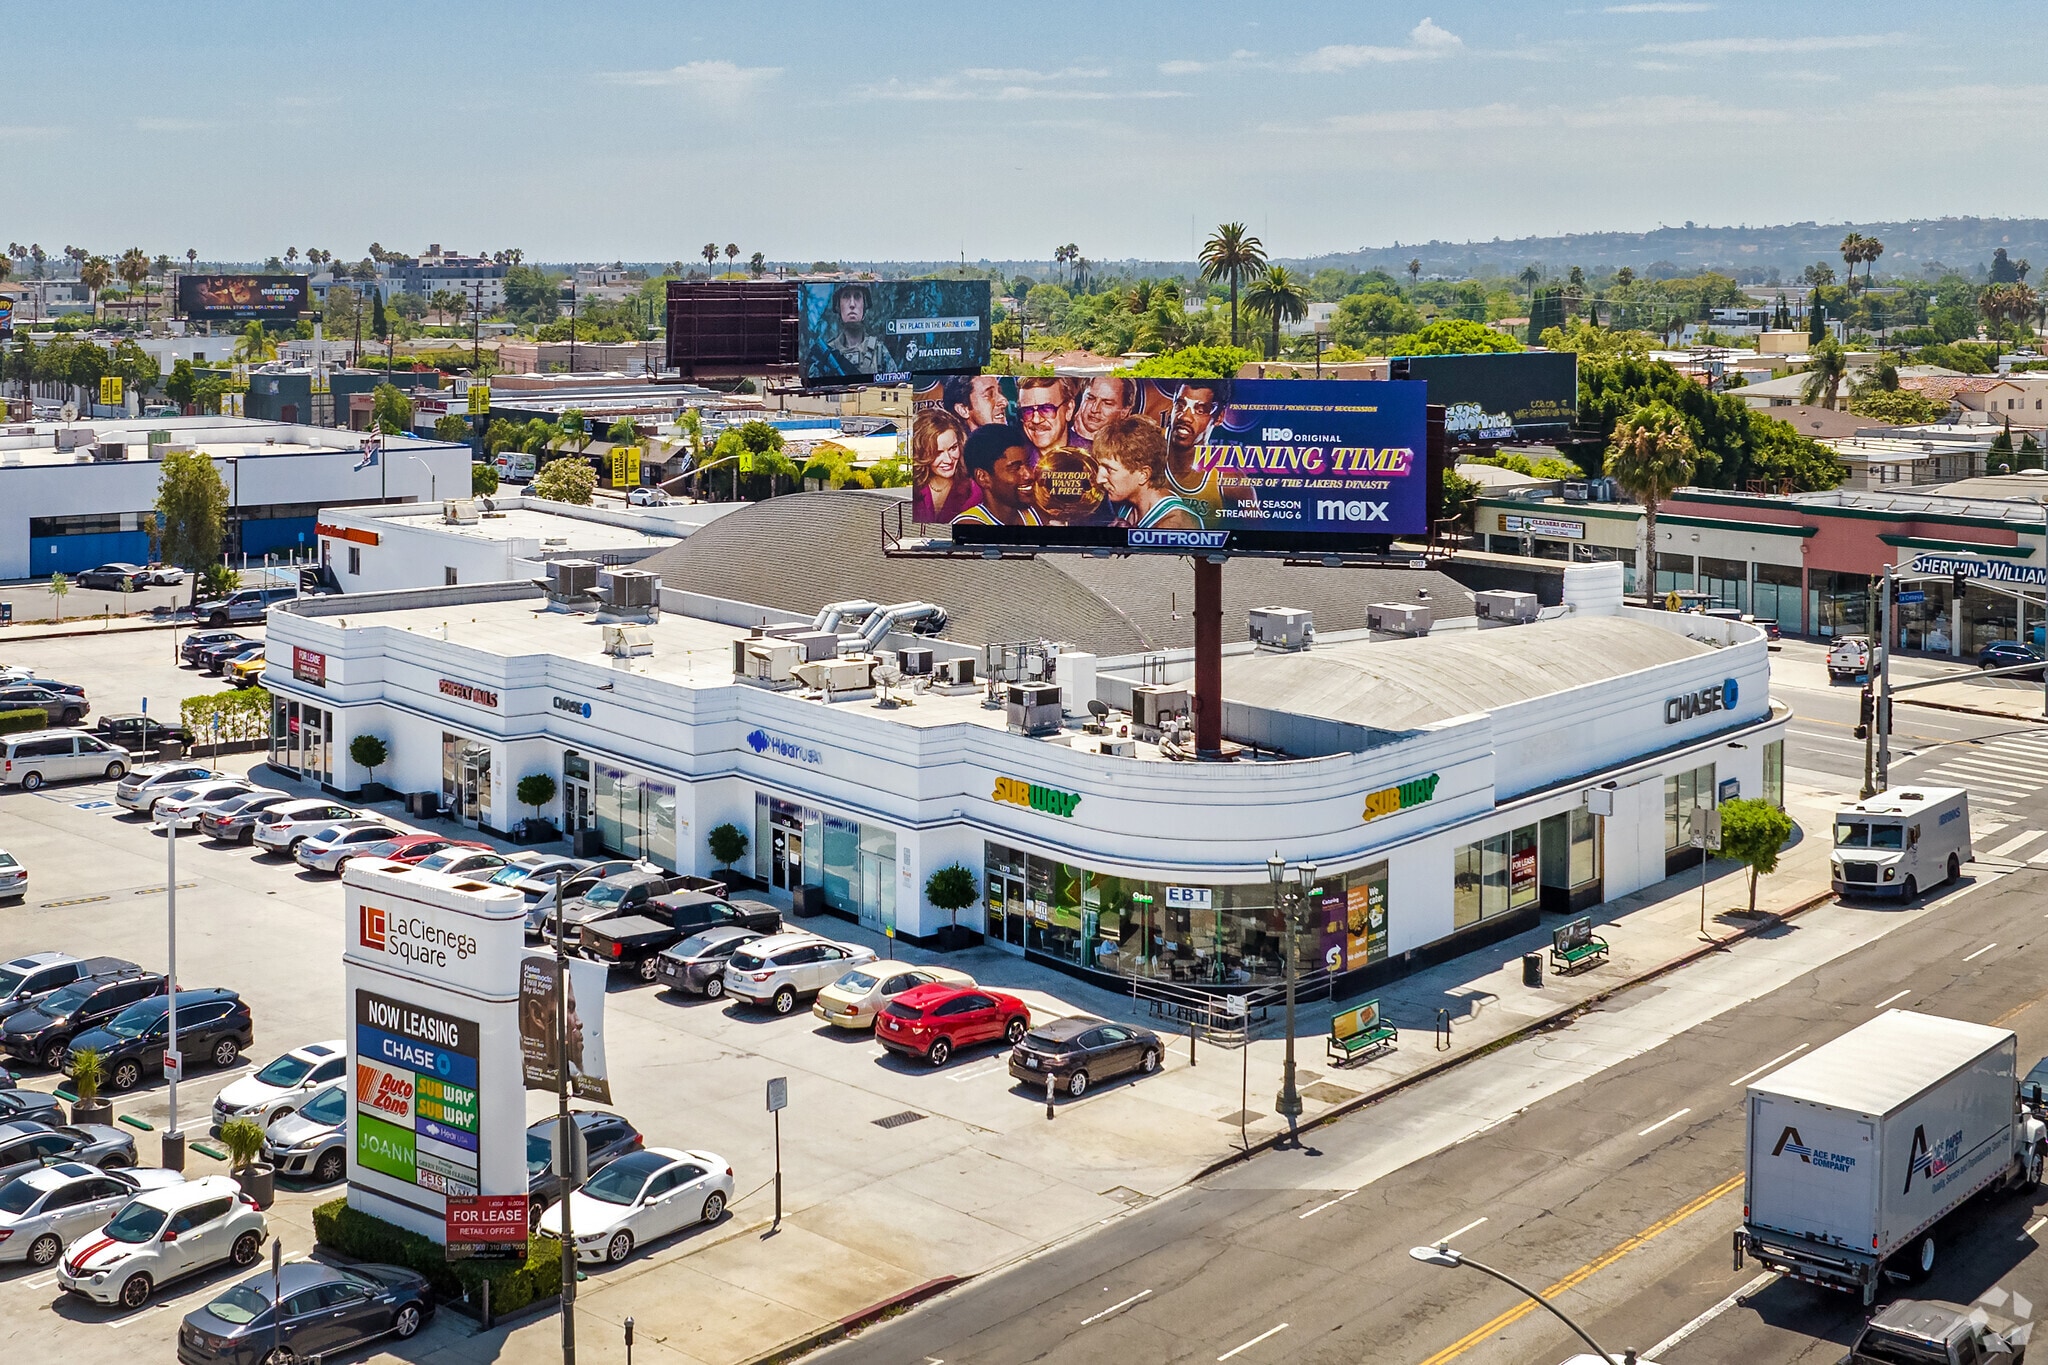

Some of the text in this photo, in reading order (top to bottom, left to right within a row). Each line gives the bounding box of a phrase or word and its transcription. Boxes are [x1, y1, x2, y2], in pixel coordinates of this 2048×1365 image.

[918, 348, 962, 357] MARINES
[875, 372, 911, 382] OUTFRONT
[1262, 428, 1342, 442] HBO ORIGINAL
[1192, 445, 1412, 475] WINNING TIME
[1042, 472, 1092, 480] EVERYBODY
[1052, 480, 1081, 488] WANTS
[1217, 477, 1390, 490] THE RISE OF THE LAKERS DYNASTY
[1058, 487, 1084, 496] PIECE
[1238, 499, 1302, 509] NEW SEASON
[1317, 500, 1390, 522] max
[1215, 509, 1302, 519] STREAMING AUG 6
[1132, 531, 1224, 545] OUTFRONT
[439, 680, 498, 708] PERFECT NAILS
[1664, 686, 1722, 724] CHASE
[992, 776, 1082, 818] SUBWAY
[1362, 772, 1440, 822] SUBWAY
[1132, 892, 1153, 904] Open
[1169, 888, 1209, 902] EBT
[388, 935, 446, 968] Square
[368, 1000, 458, 1047] NOW LEASING
[383, 1038, 434, 1070] CHASE
[380, 1073, 414, 1099] Auto
[418, 1078, 474, 1106] SUBWAY
[373, 1089, 410, 1118] Zone
[418, 1099, 474, 1128] SUBWAY
[360, 1133, 414, 1166] JOANN
[1813, 1149, 1856, 1166] ACE PAPER
[1812, 1158, 1850, 1173] COMPANY
[421, 1170, 442, 1186] PETS
[450, 1185, 476, 1196] NAIL
[454, 1210, 522, 1222] FOR LEASE
